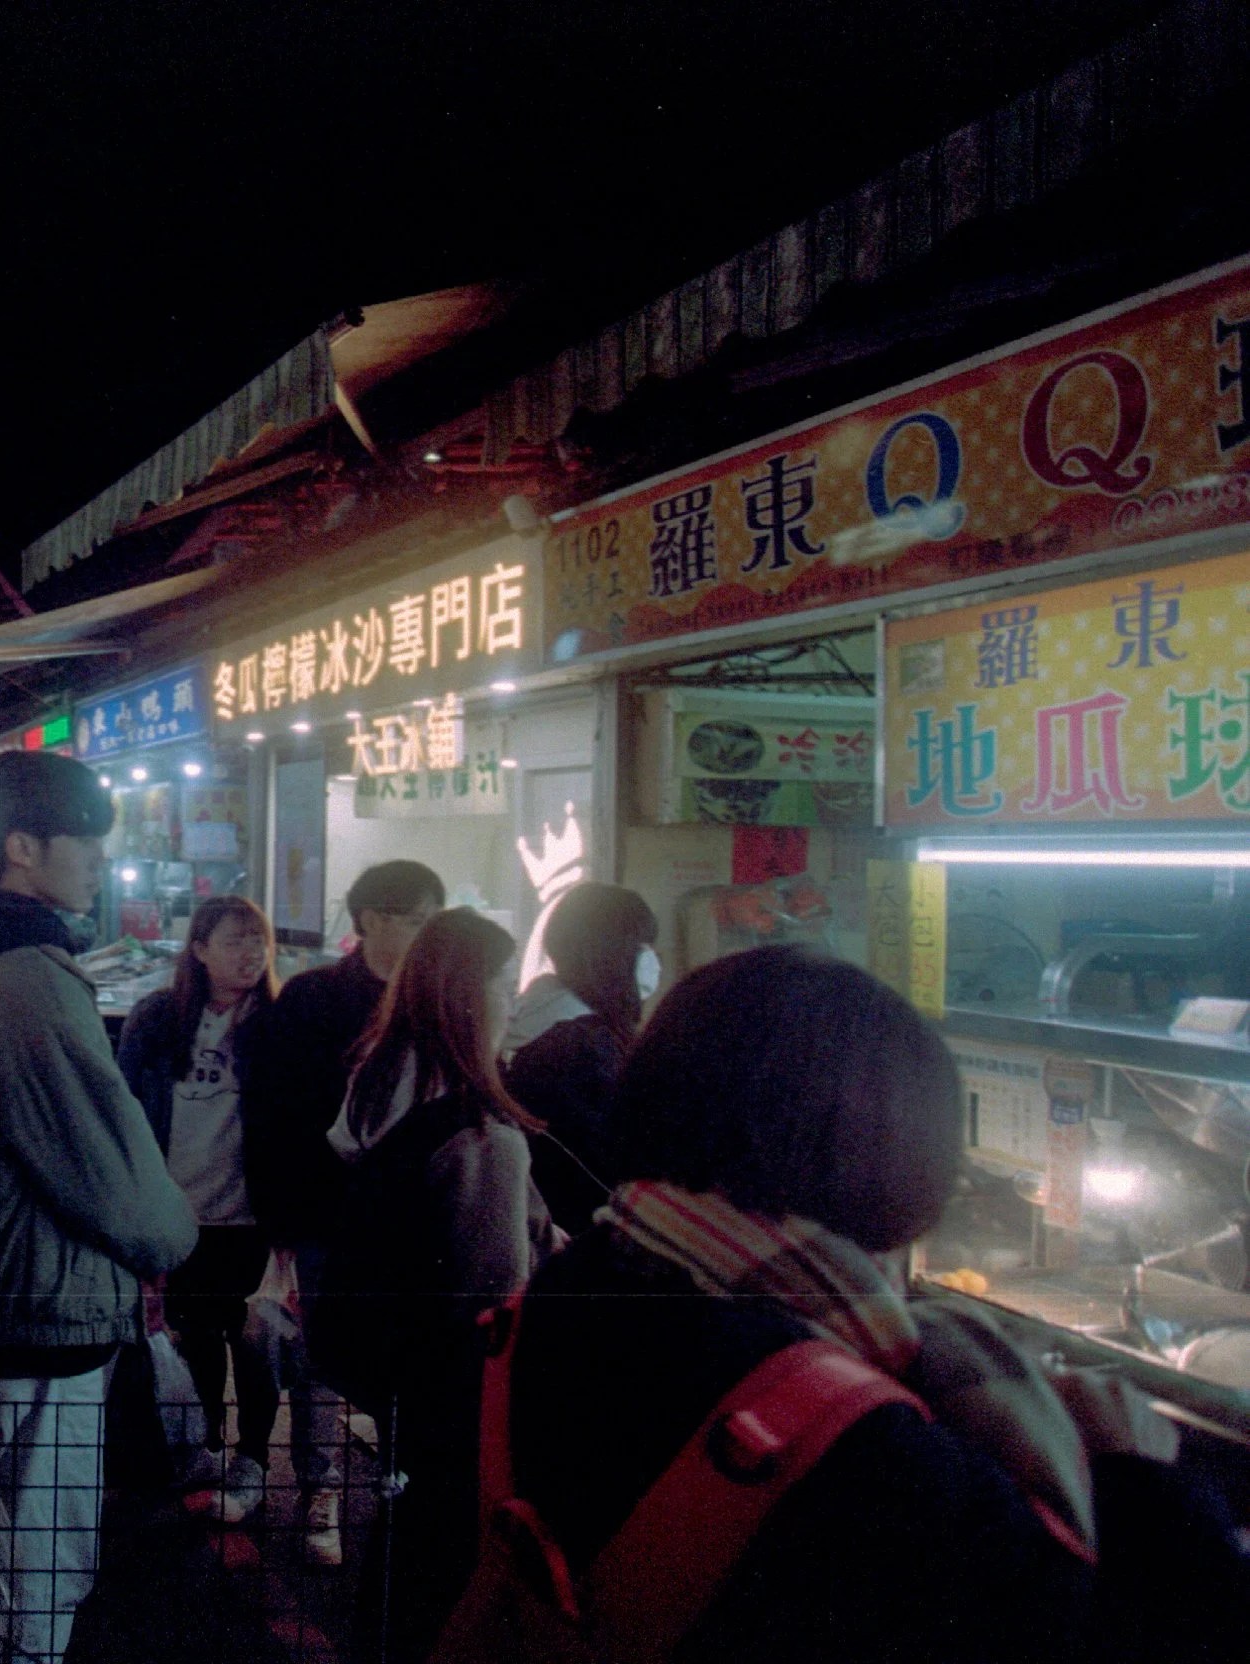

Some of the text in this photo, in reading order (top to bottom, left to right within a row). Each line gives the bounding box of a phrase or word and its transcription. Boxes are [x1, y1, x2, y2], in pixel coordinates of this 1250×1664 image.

[558, 519, 620, 573] 1102
[213, 562, 525, 721] 冬瓜檸檬冰沙專門店
[975, 580, 1187, 688] 羅東
[905, 673, 1250, 817] 地瓜球
